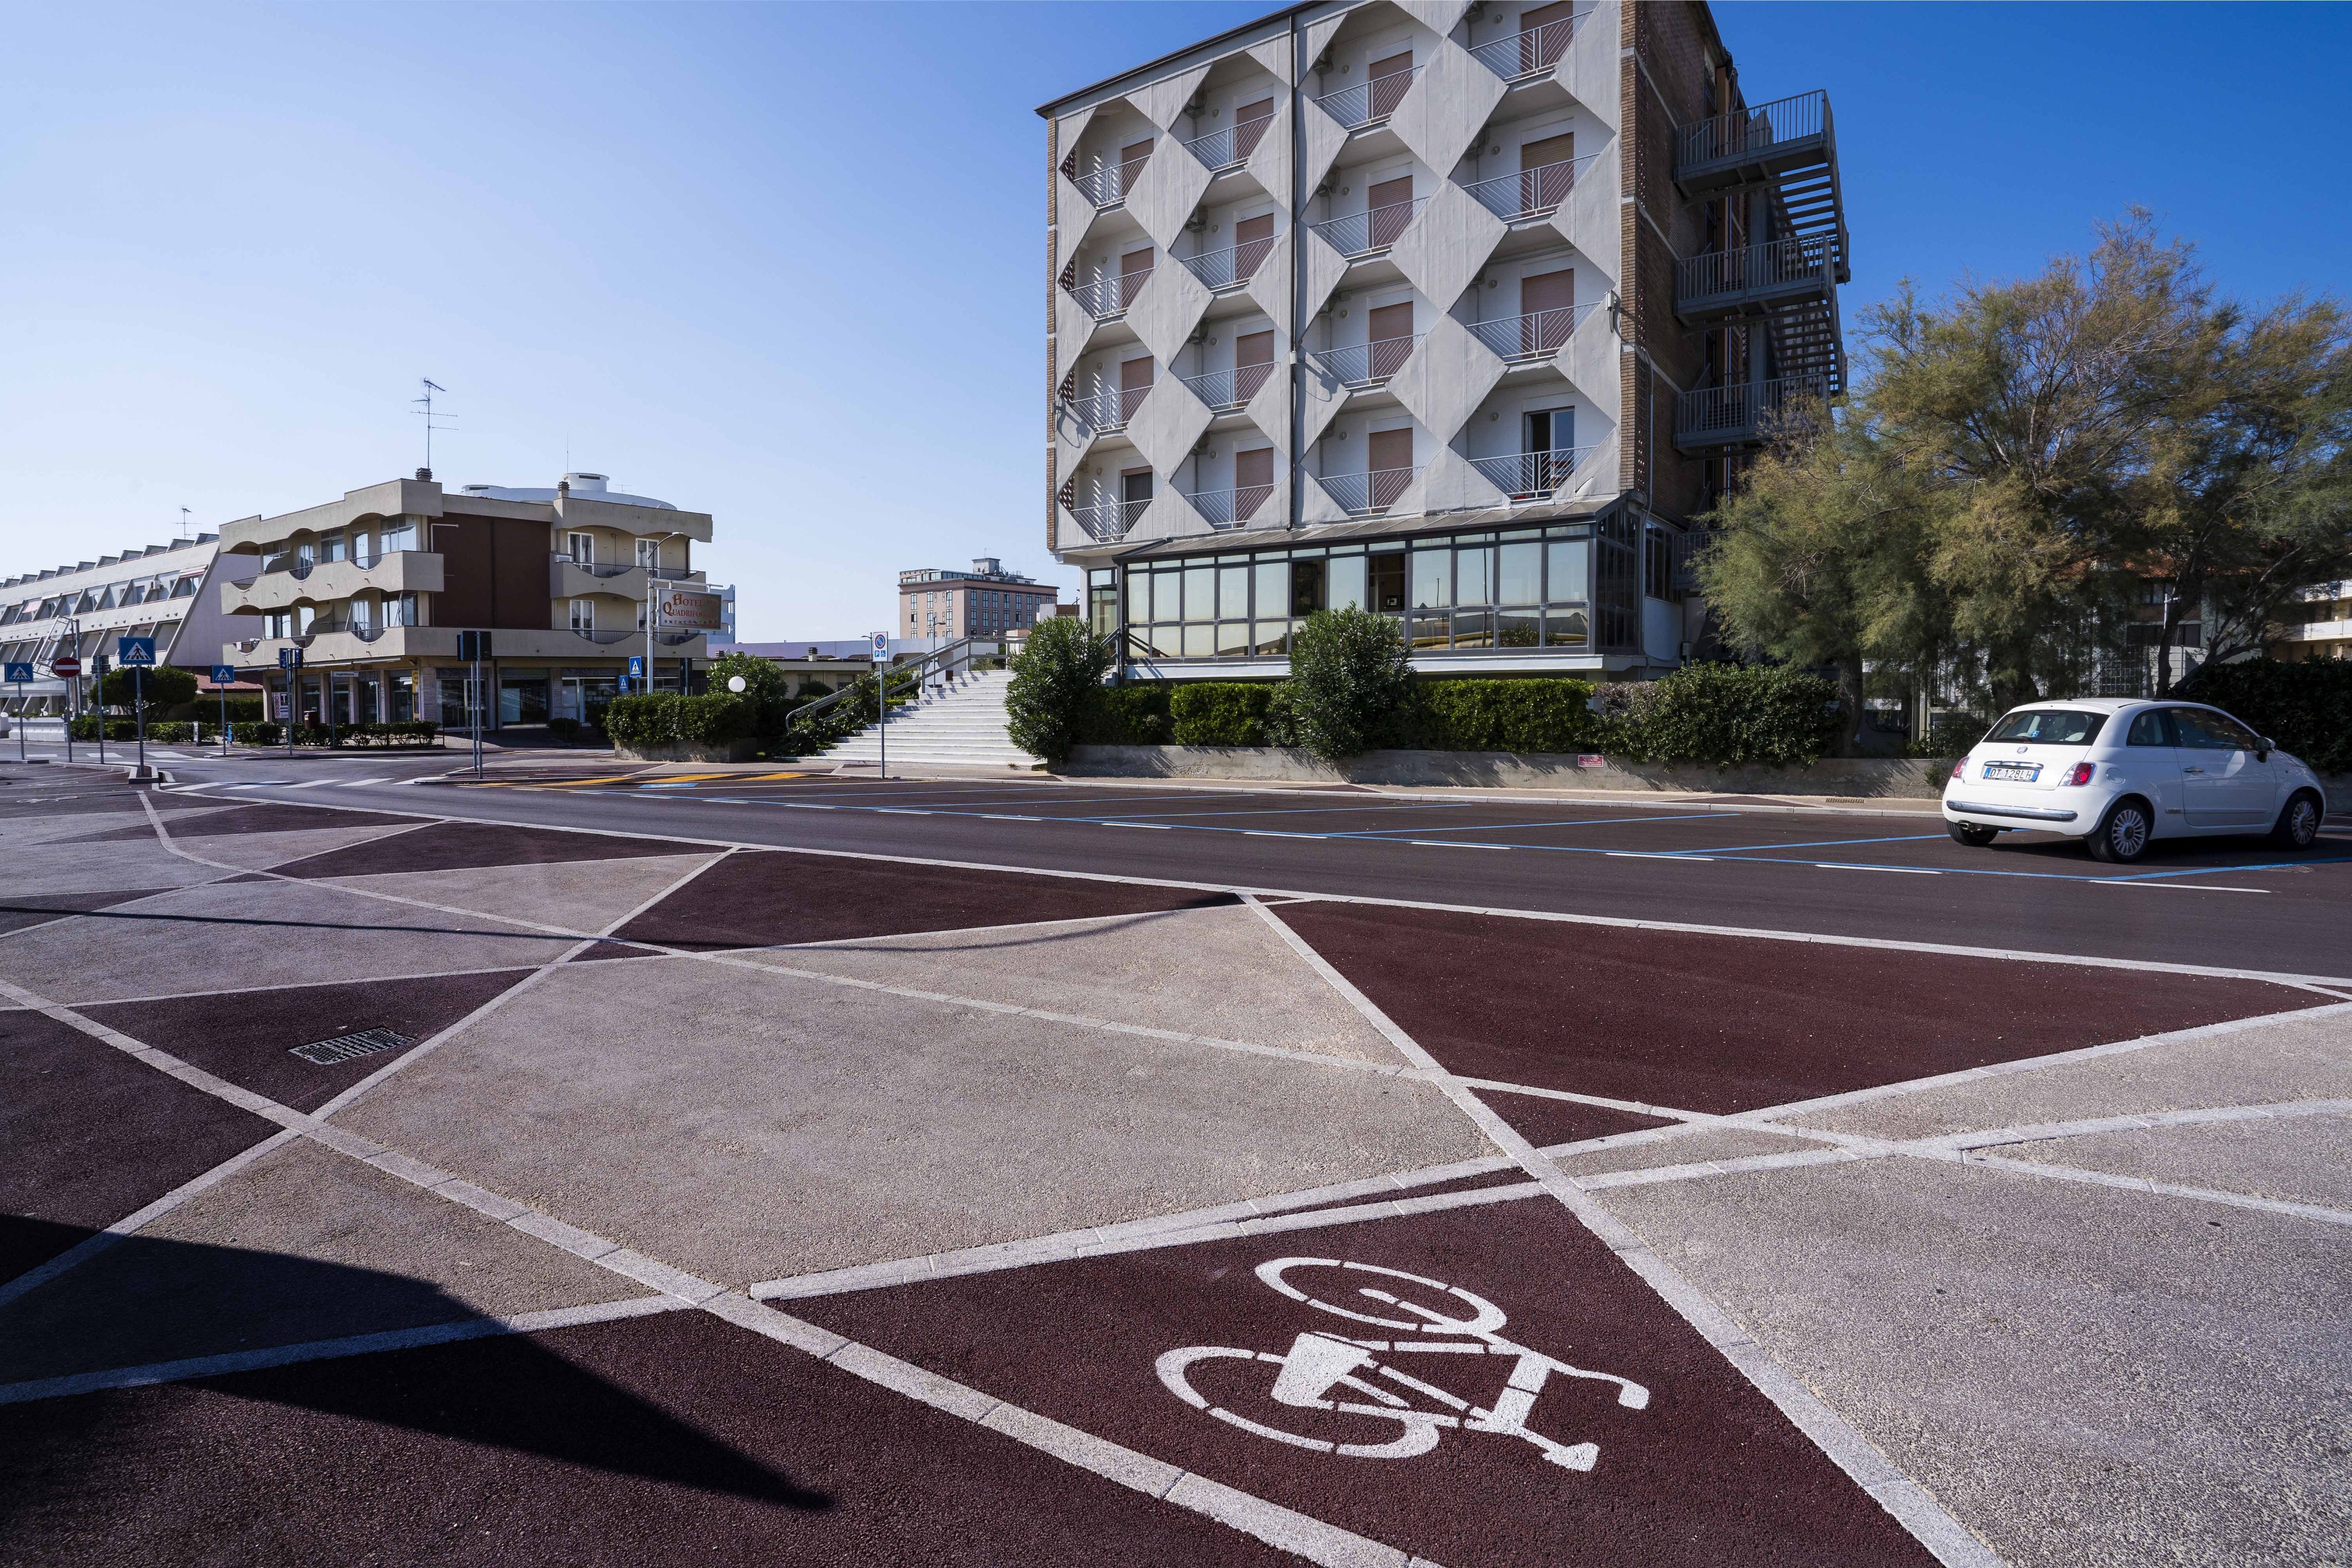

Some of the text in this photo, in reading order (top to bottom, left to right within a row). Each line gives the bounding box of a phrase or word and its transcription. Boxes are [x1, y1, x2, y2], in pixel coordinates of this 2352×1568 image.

[662, 601, 716, 619] QUADRIFOG
[1989, 769, 2032, 779] DT 128LH
